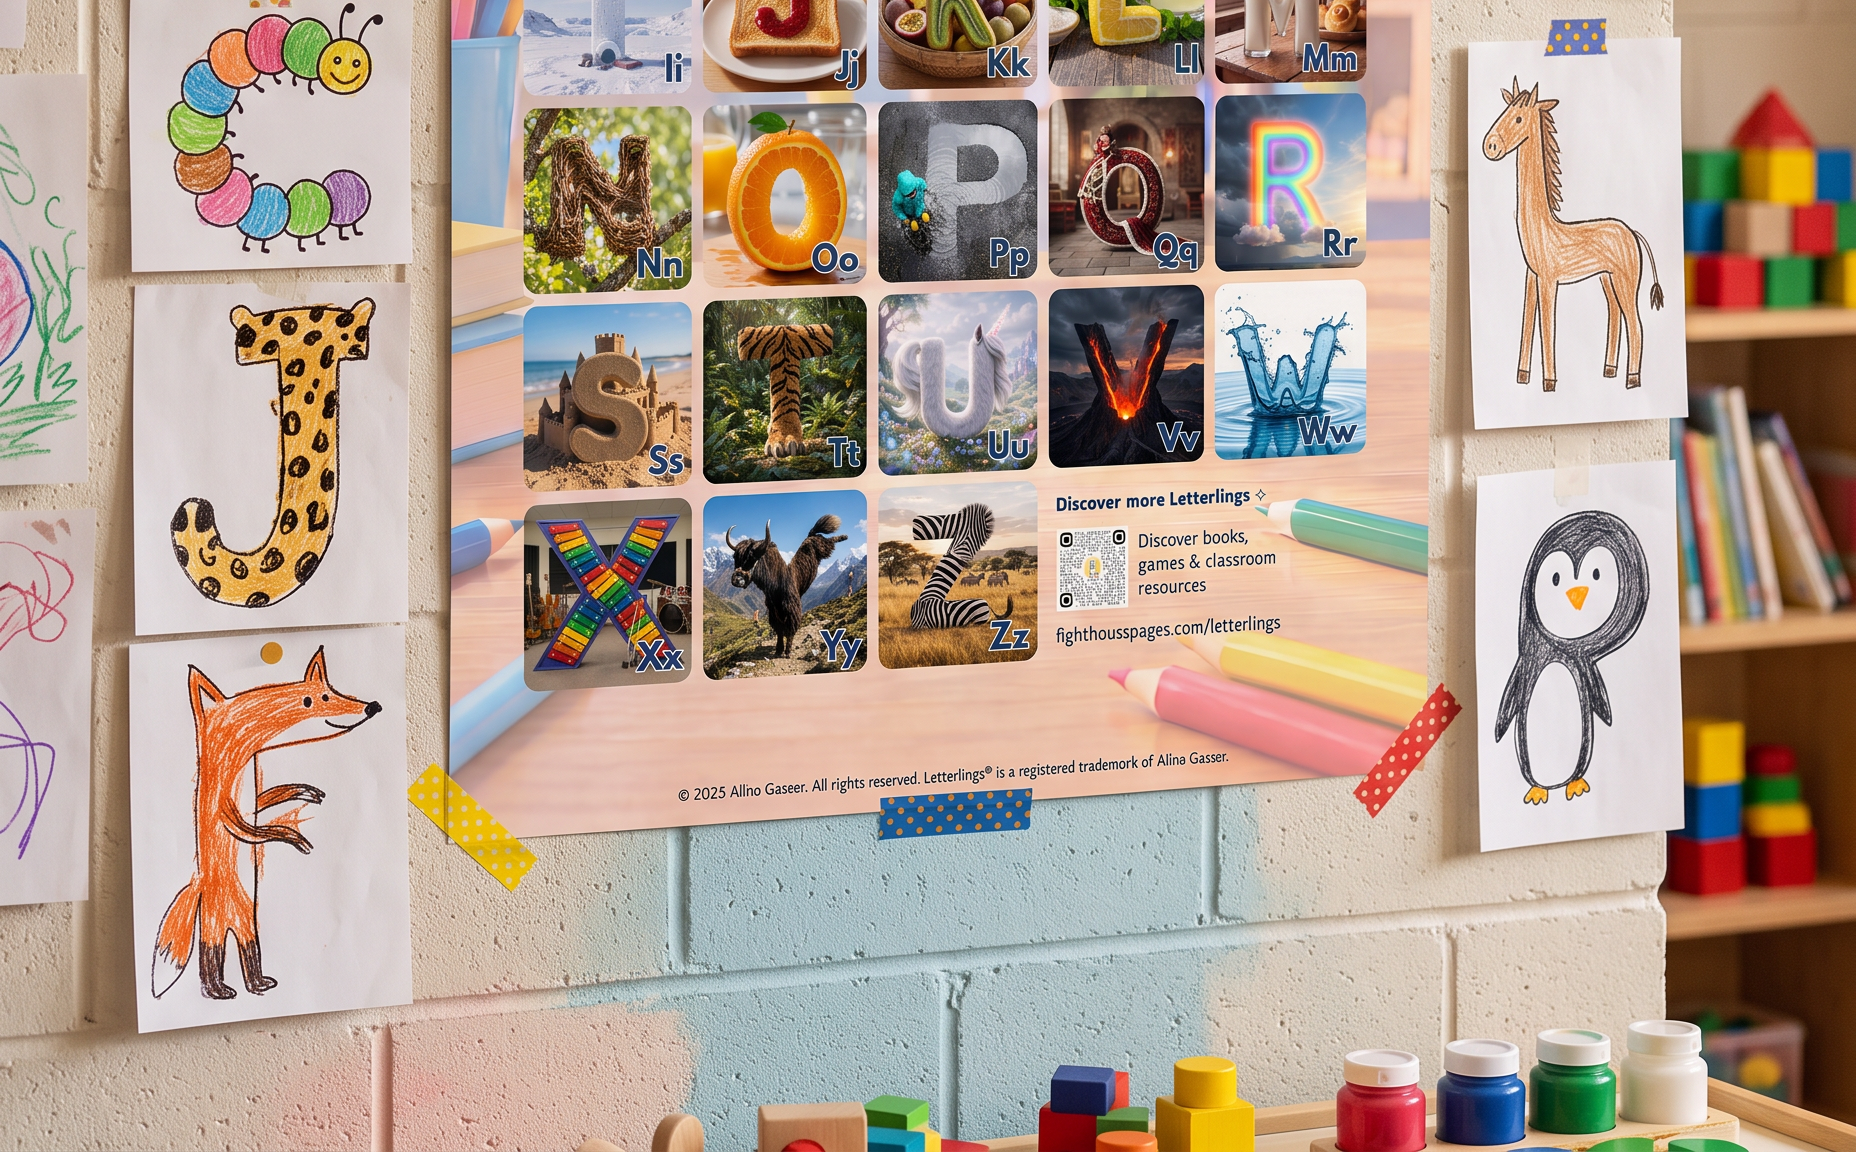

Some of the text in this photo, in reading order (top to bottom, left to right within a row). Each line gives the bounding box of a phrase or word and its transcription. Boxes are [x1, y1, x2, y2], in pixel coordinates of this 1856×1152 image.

[835, 48, 859, 90] Jj
[987, 47, 1032, 78] Kk
[1302, 42, 1358, 72] Mm
[989, 237, 1030, 276] Pp
[1153, 232, 1198, 270] Qq
[1323, 227, 1359, 257] Rr
[636, 247, 683, 279] Nn
[811, 241, 860, 275] Oo
[988, 430, 1030, 461] Uu
[1156, 421, 1200, 453] Vv
[1297, 416, 1359, 446] Ww
[648, 445, 684, 476] Ss
[827, 436, 860, 469] Tt
[1056, 488, 1250, 512] Discover more Letterlings
[1138, 529, 1249, 548] Discover books,
[1138, 552, 1276, 575] games & classroom
[1138, 580, 1207, 596] resources
[988, 619, 1030, 652] Zz
[1056, 616, 1281, 647] fighthousspages.com/letterlings
[635, 639, 685, 673] Xx
[820, 629, 862, 671] Yy
[694, 786, 726, 801] 2025
[812, 778, 828, 792] All
[831, 776, 865, 794] rights
[868, 772, 921, 788] reserved.
[996, 766, 1005, 779] is
[1008, 768, 1016, 778] a
[1018, 760, 1075, 780] registered
[1141, 754, 1154, 768] of
[1189, 751, 1229, 765] Gasser.
